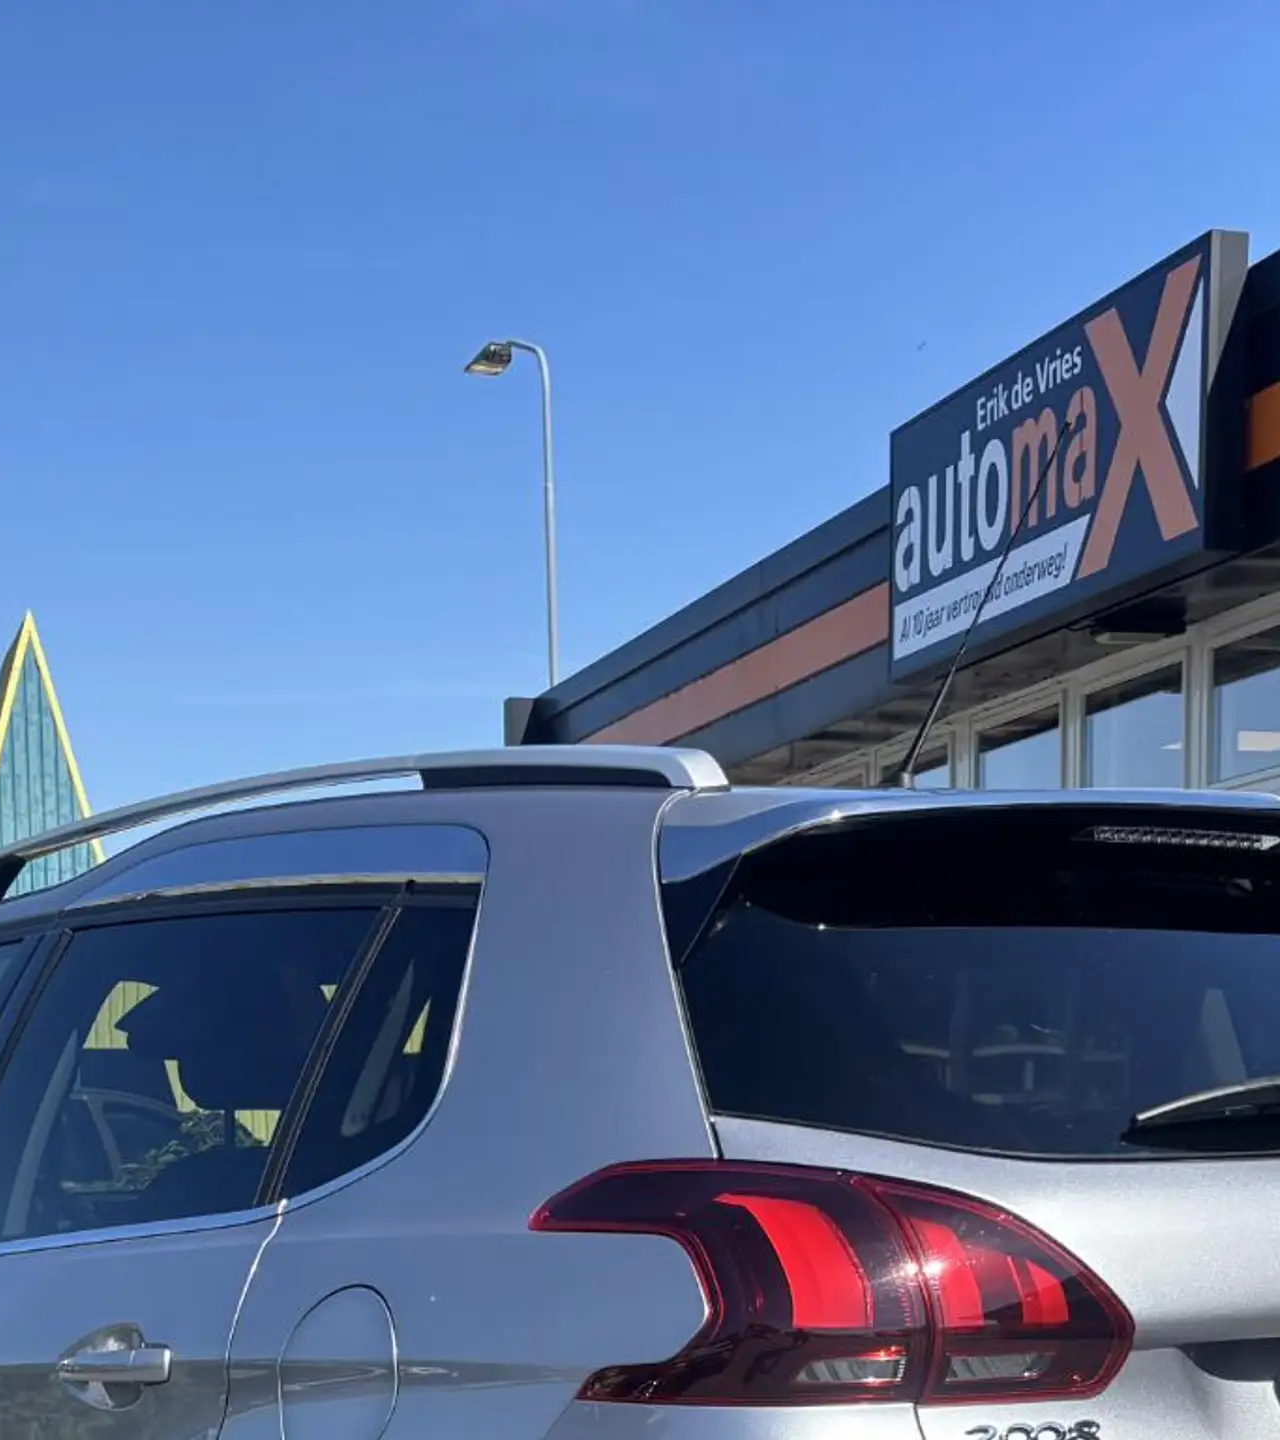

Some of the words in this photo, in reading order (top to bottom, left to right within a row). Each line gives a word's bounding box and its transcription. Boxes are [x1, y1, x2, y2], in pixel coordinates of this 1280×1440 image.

[976, 380, 1010, 432] Erik
[1011, 374, 1034, 411] de
[1035, 344, 1083, 393] Vries
